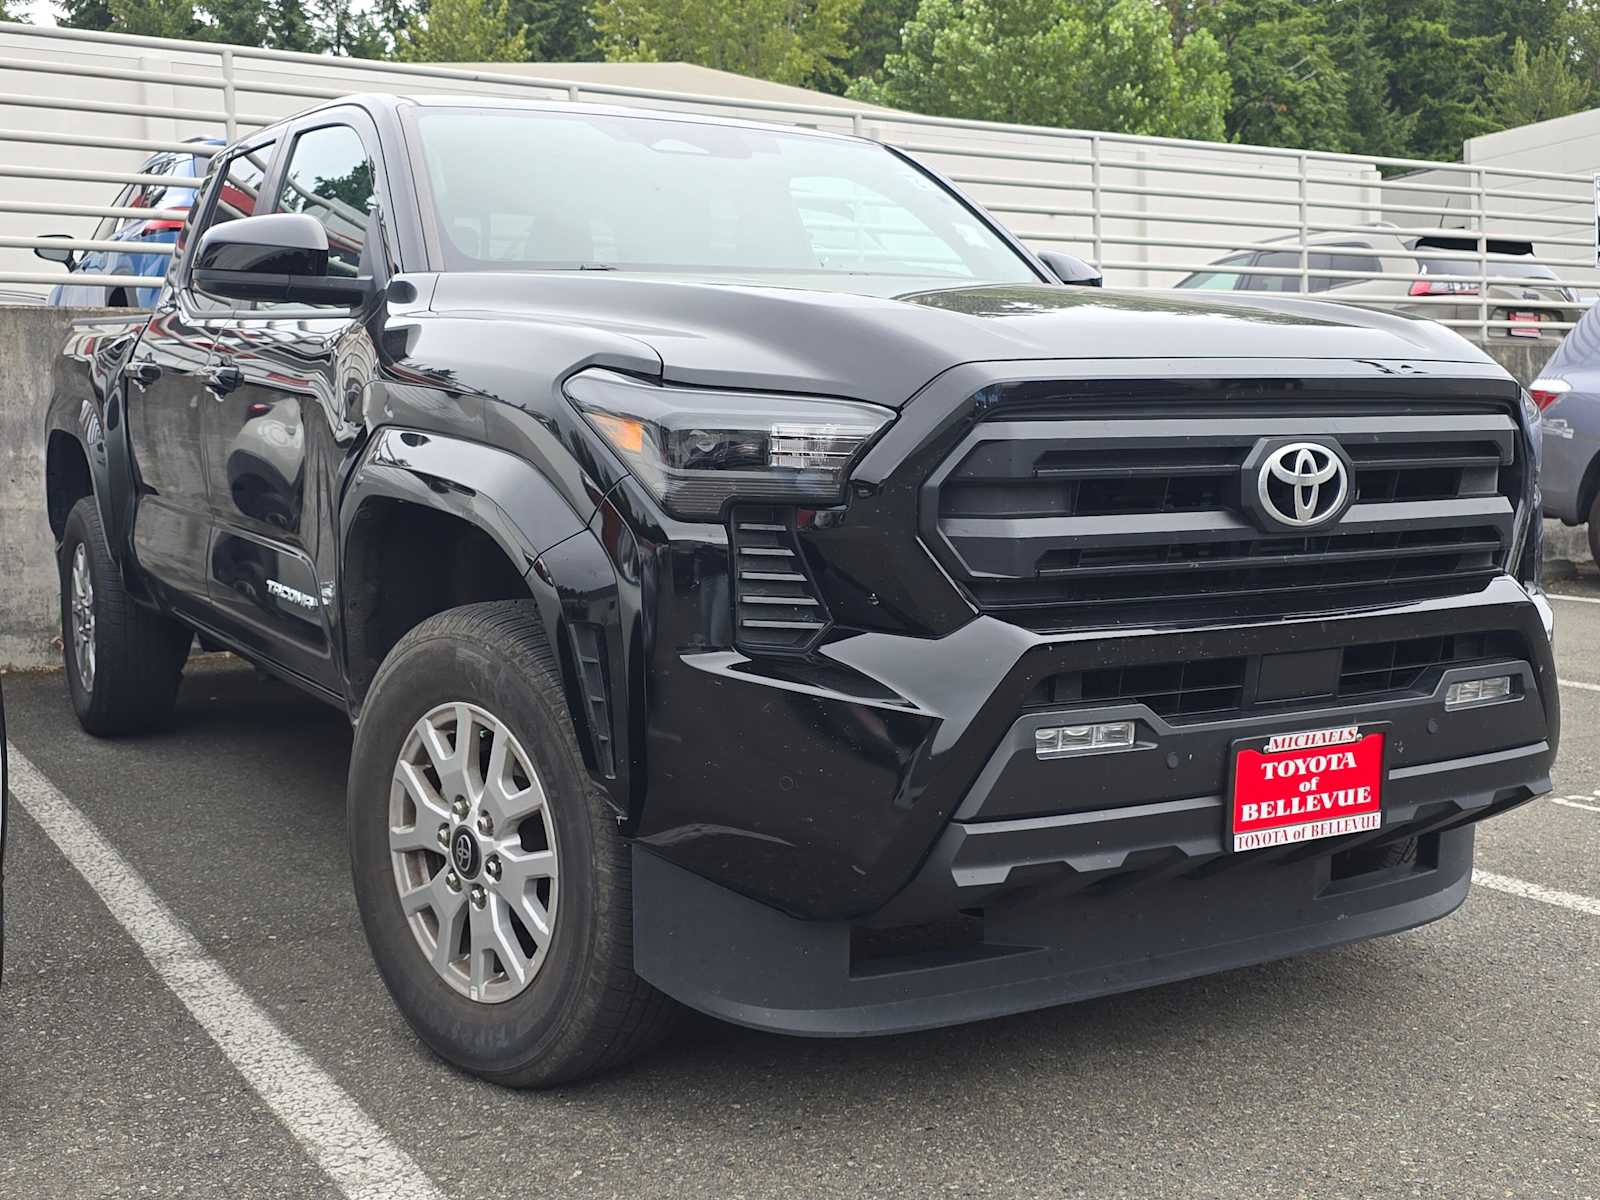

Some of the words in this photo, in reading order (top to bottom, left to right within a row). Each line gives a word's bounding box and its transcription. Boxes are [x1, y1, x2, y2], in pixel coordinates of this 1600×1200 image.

[1271, 727, 1357, 750] MICHAELS
[1261, 752, 1357, 780] TOYOTA
[1299, 777, 1320, 793] of
[1241, 786, 1372, 822] BELLEVUE
[1236, 829, 1289, 850] TOYOTA
[1293, 828, 1306, 841] of
[1311, 813, 1380, 837] BELLEVUE
